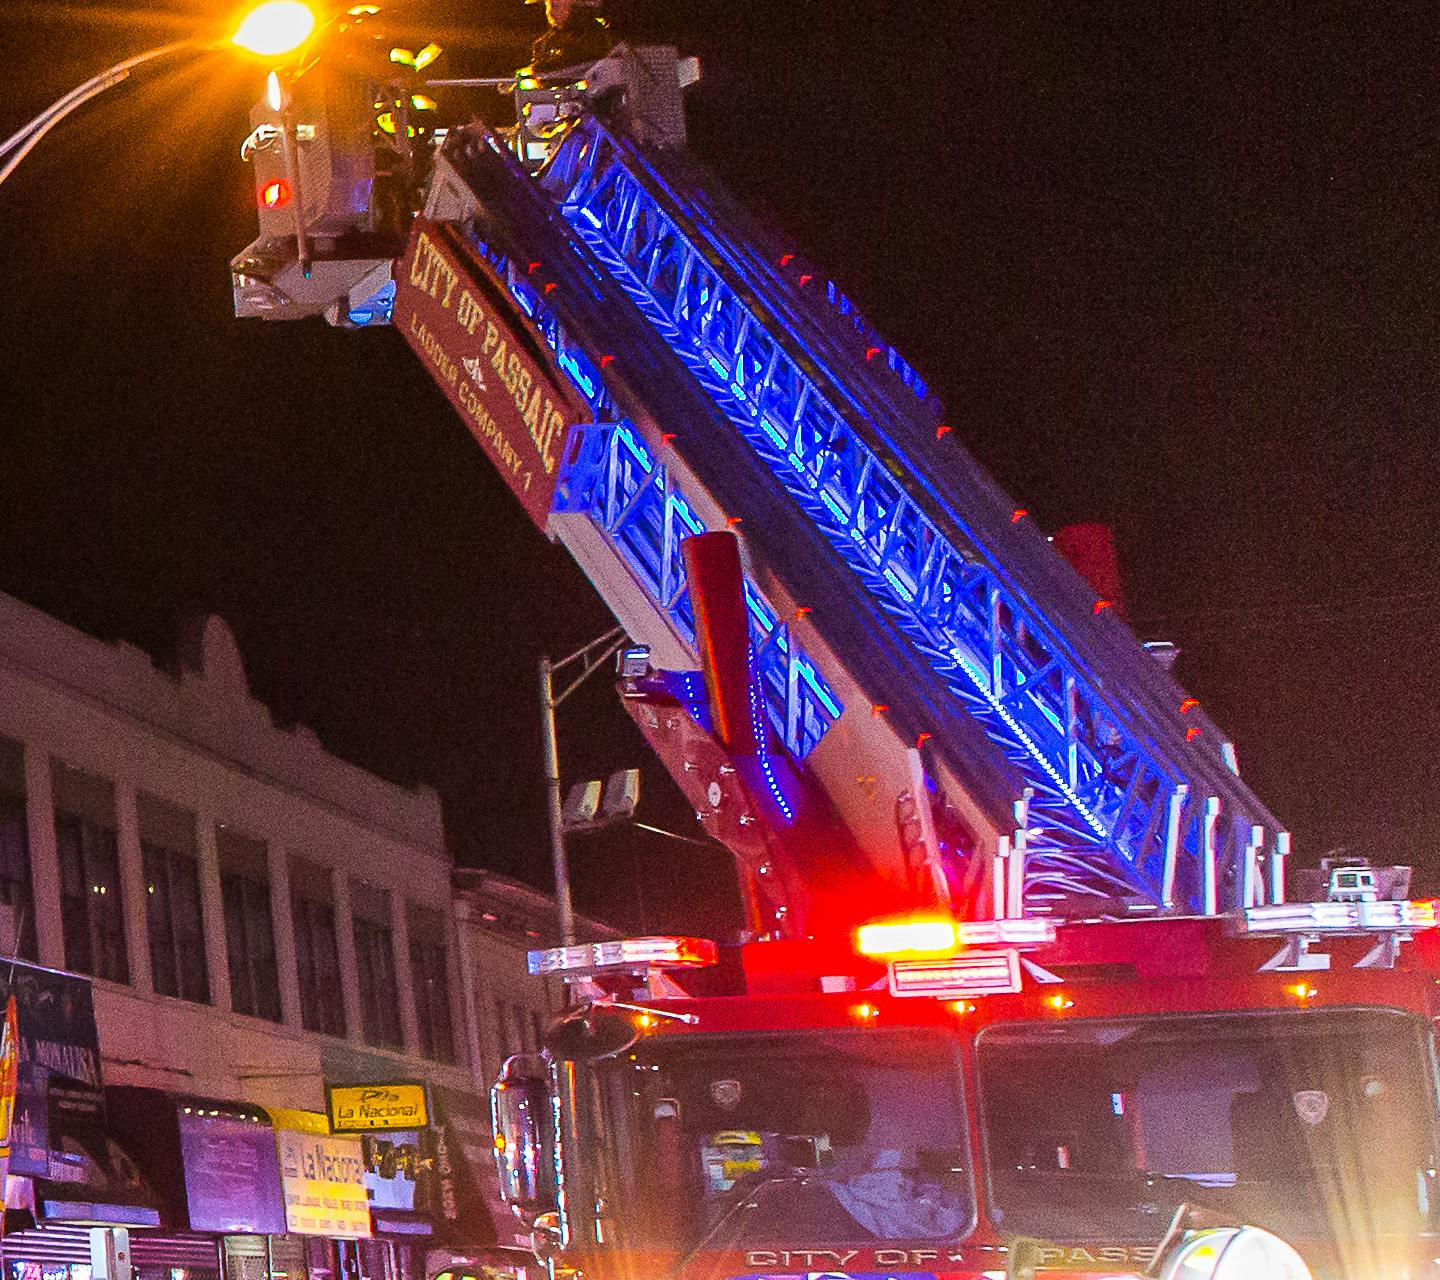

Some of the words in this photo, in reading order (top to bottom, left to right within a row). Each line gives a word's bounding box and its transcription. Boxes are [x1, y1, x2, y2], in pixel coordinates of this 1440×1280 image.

[410, 232, 459, 309] CITY
[457, 290, 484, 335] OF
[483, 321, 564, 474] PASSAIC
[411, 312, 458, 387] LADDER
[458, 381, 523, 475] COMPANY
[522, 472, 533, 491] 1
[338, 1106, 355, 1119] La
[359, 1102, 418, 1119] Nacional
[746, 1250, 858, 1266] CITY
[874, 1249, 938, 1265] OF
[1038, 1247, 1155, 1263] PASS
